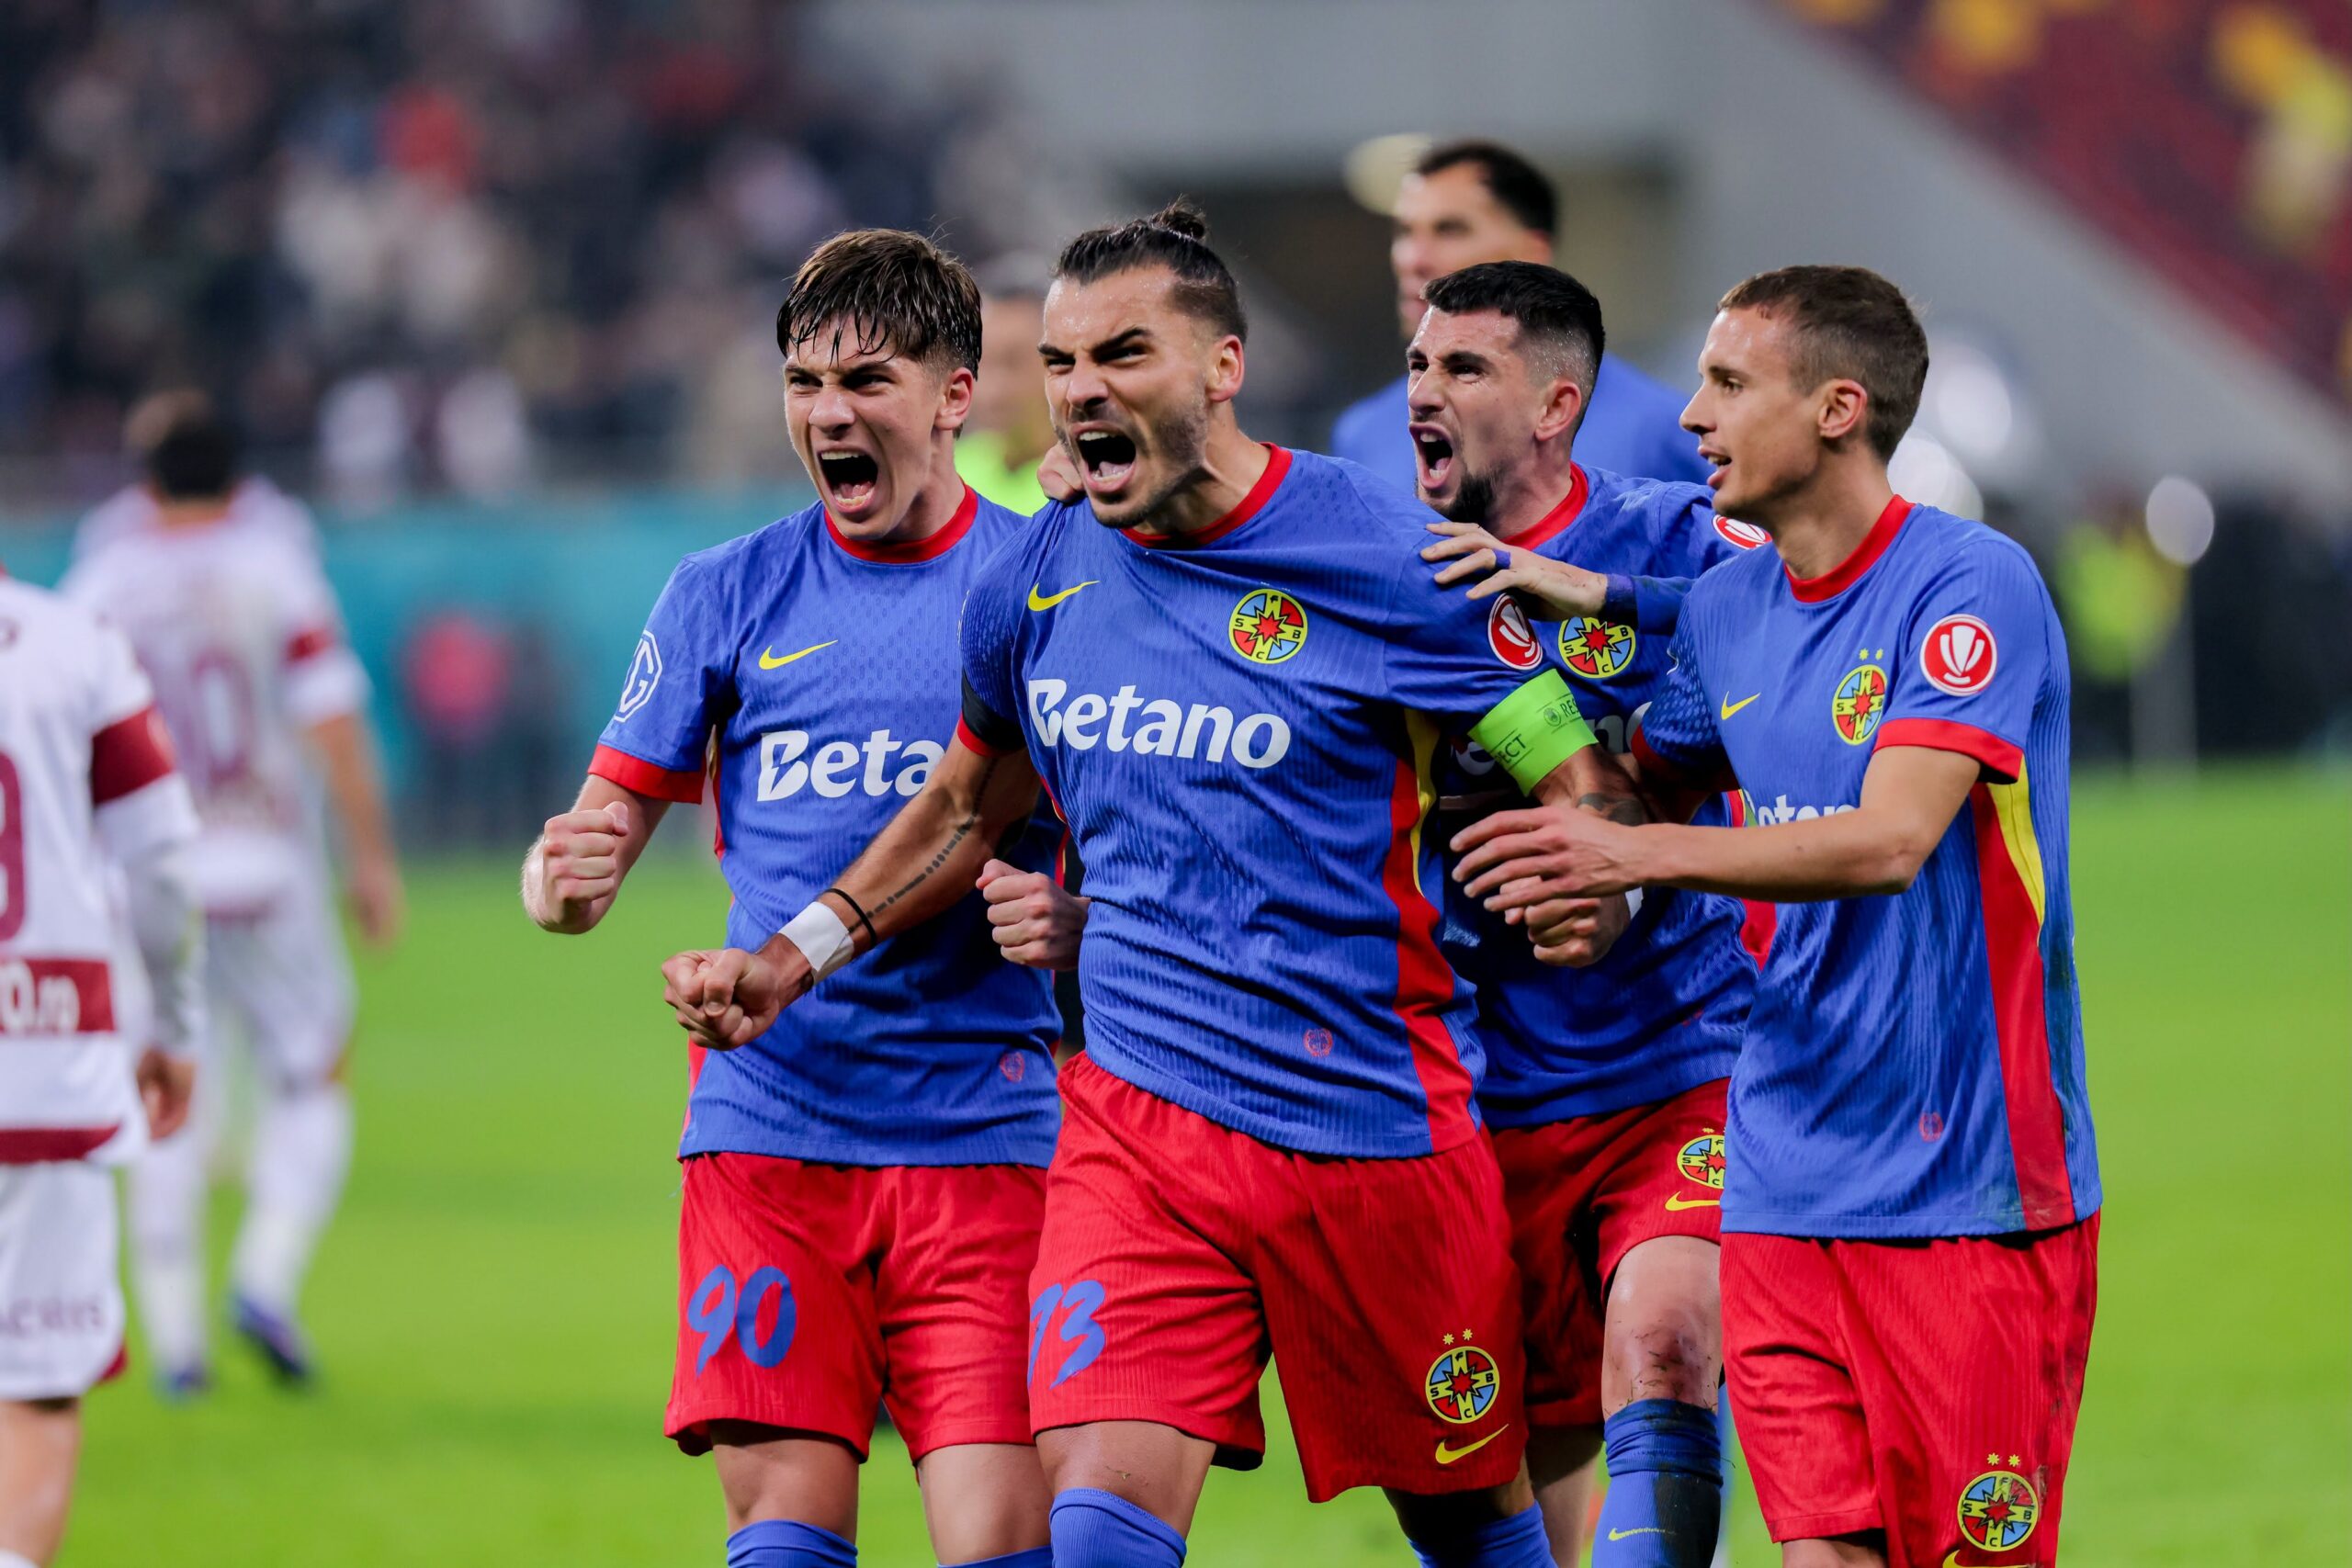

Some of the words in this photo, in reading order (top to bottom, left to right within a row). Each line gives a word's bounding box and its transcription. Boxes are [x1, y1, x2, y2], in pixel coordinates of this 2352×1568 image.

[1235, 617, 1244, 627] S
[1293, 629, 1301, 639] B
[1621, 626, 1629, 637] B
[1565, 644, 1575, 654] S
[1257, 651, 1265, 660] C
[1602, 663, 1611, 673] C
[1838, 702, 1845, 712] S
[1028, 679, 1292, 769] Betano
[687, 1264, 797, 1377] 90
[1430, 1386, 1440, 1397] S
[1486, 1372, 1494, 1382] B
[1464, 1408, 1473, 1418] C
[1963, 1503, 1973, 1513] S
[2024, 1509, 2032, 1520] B
[1990, 1537, 1998, 1547] C
